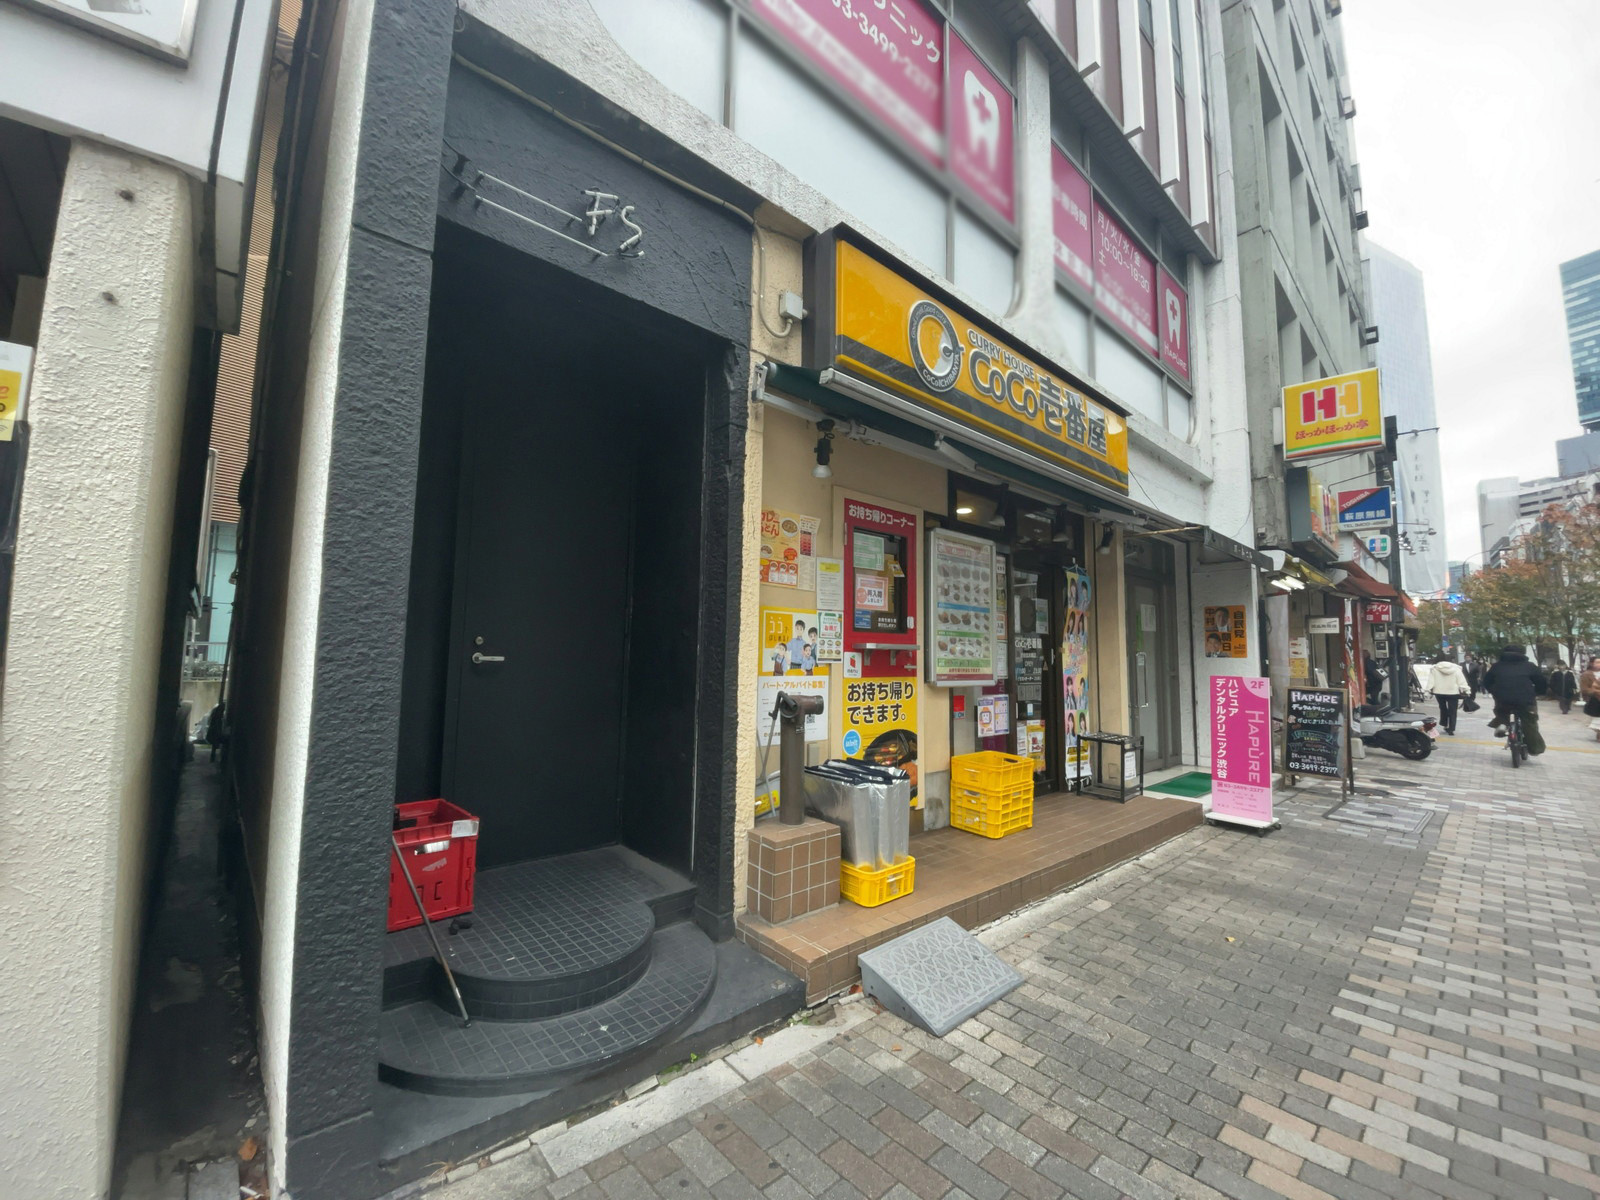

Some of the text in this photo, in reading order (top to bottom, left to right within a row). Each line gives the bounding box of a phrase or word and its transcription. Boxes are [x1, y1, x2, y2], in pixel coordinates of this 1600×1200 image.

[968, 329, 1035, 381] CURRY HOUSE
[968, 348, 1108, 457] CoCo壱番屋
[1341, 490, 1371, 509] TOSHIBA
[849, 504, 915, 528] お持ち帰りコーナー
[847, 681, 914, 702] お持ち帰り
[1250, 680, 1265, 690] 2F
[847, 703, 906, 725] できます。
[1215, 678, 1228, 779] デンタルクリニック渋谷
[1289, 761, 1338, 774] 03-3499-2377
